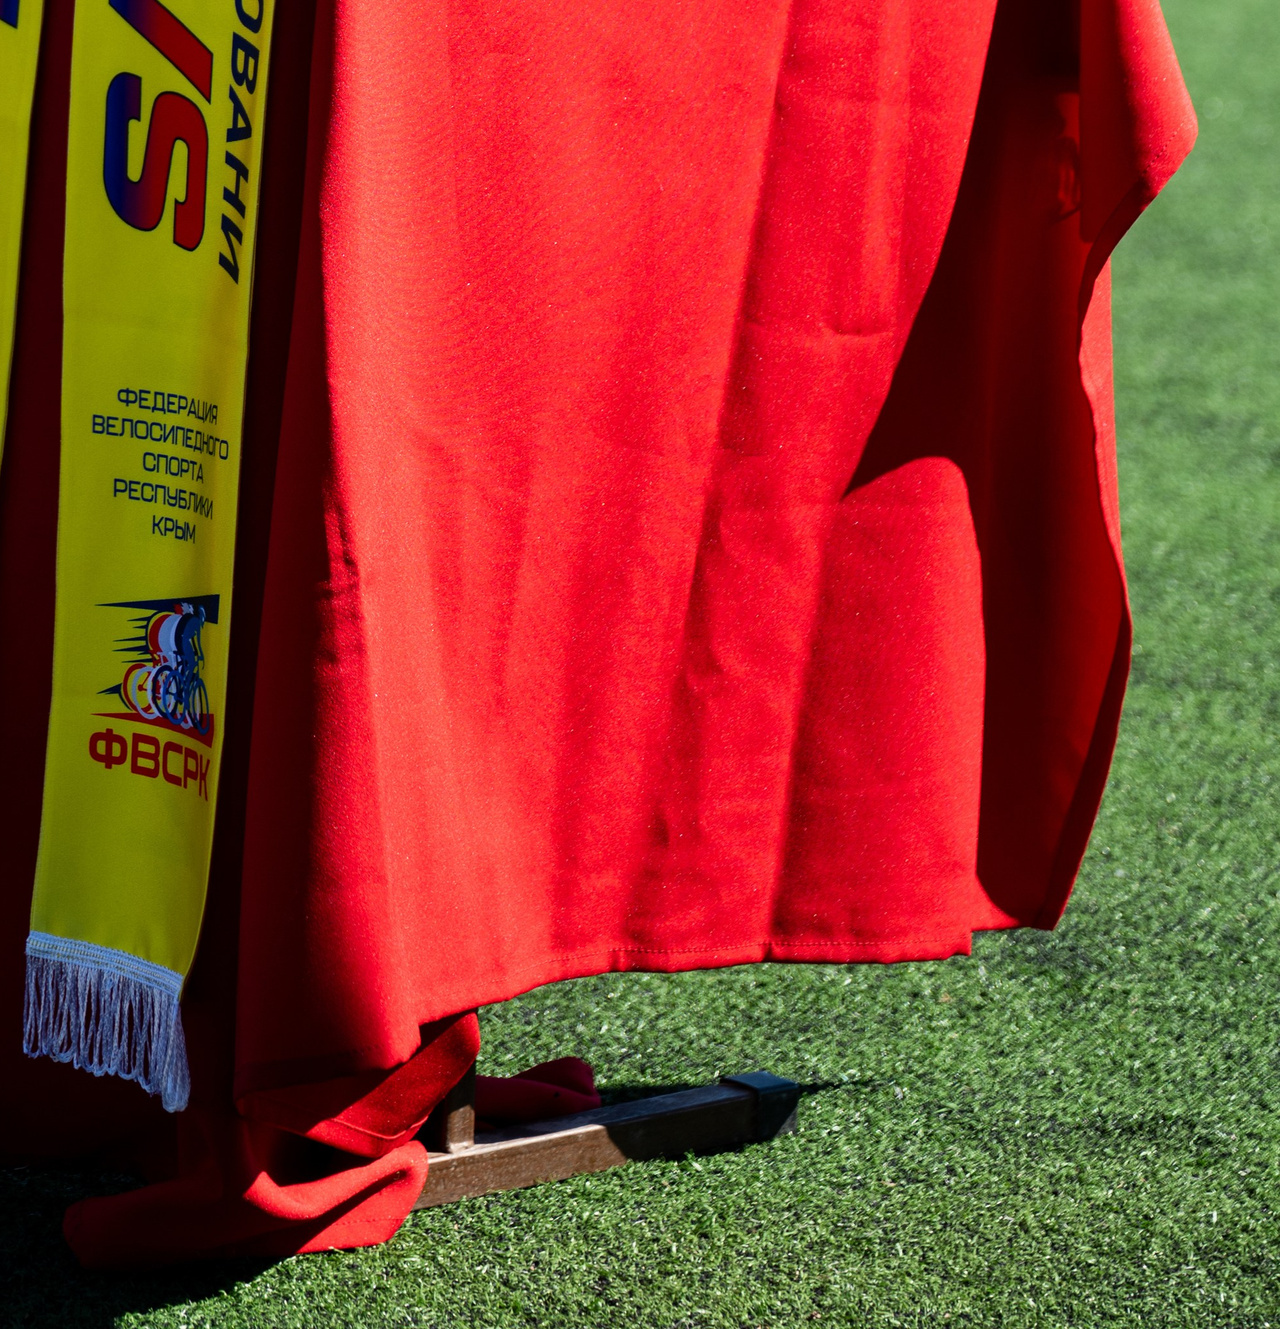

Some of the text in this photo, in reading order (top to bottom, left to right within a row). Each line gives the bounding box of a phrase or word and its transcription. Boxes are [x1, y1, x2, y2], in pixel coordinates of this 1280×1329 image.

[118, 387, 219, 426] ФЕДЕРАЦИЯ
[92, 414, 229, 461] ВЕЛОСИПЕДНОГО
[142, 452, 204, 484] СПОРТА
[113, 478, 214, 520] РЕСПУБЛИКИ
[152, 514, 196, 544] КРЫМ
[88, 728, 210, 802] ФВСРК
